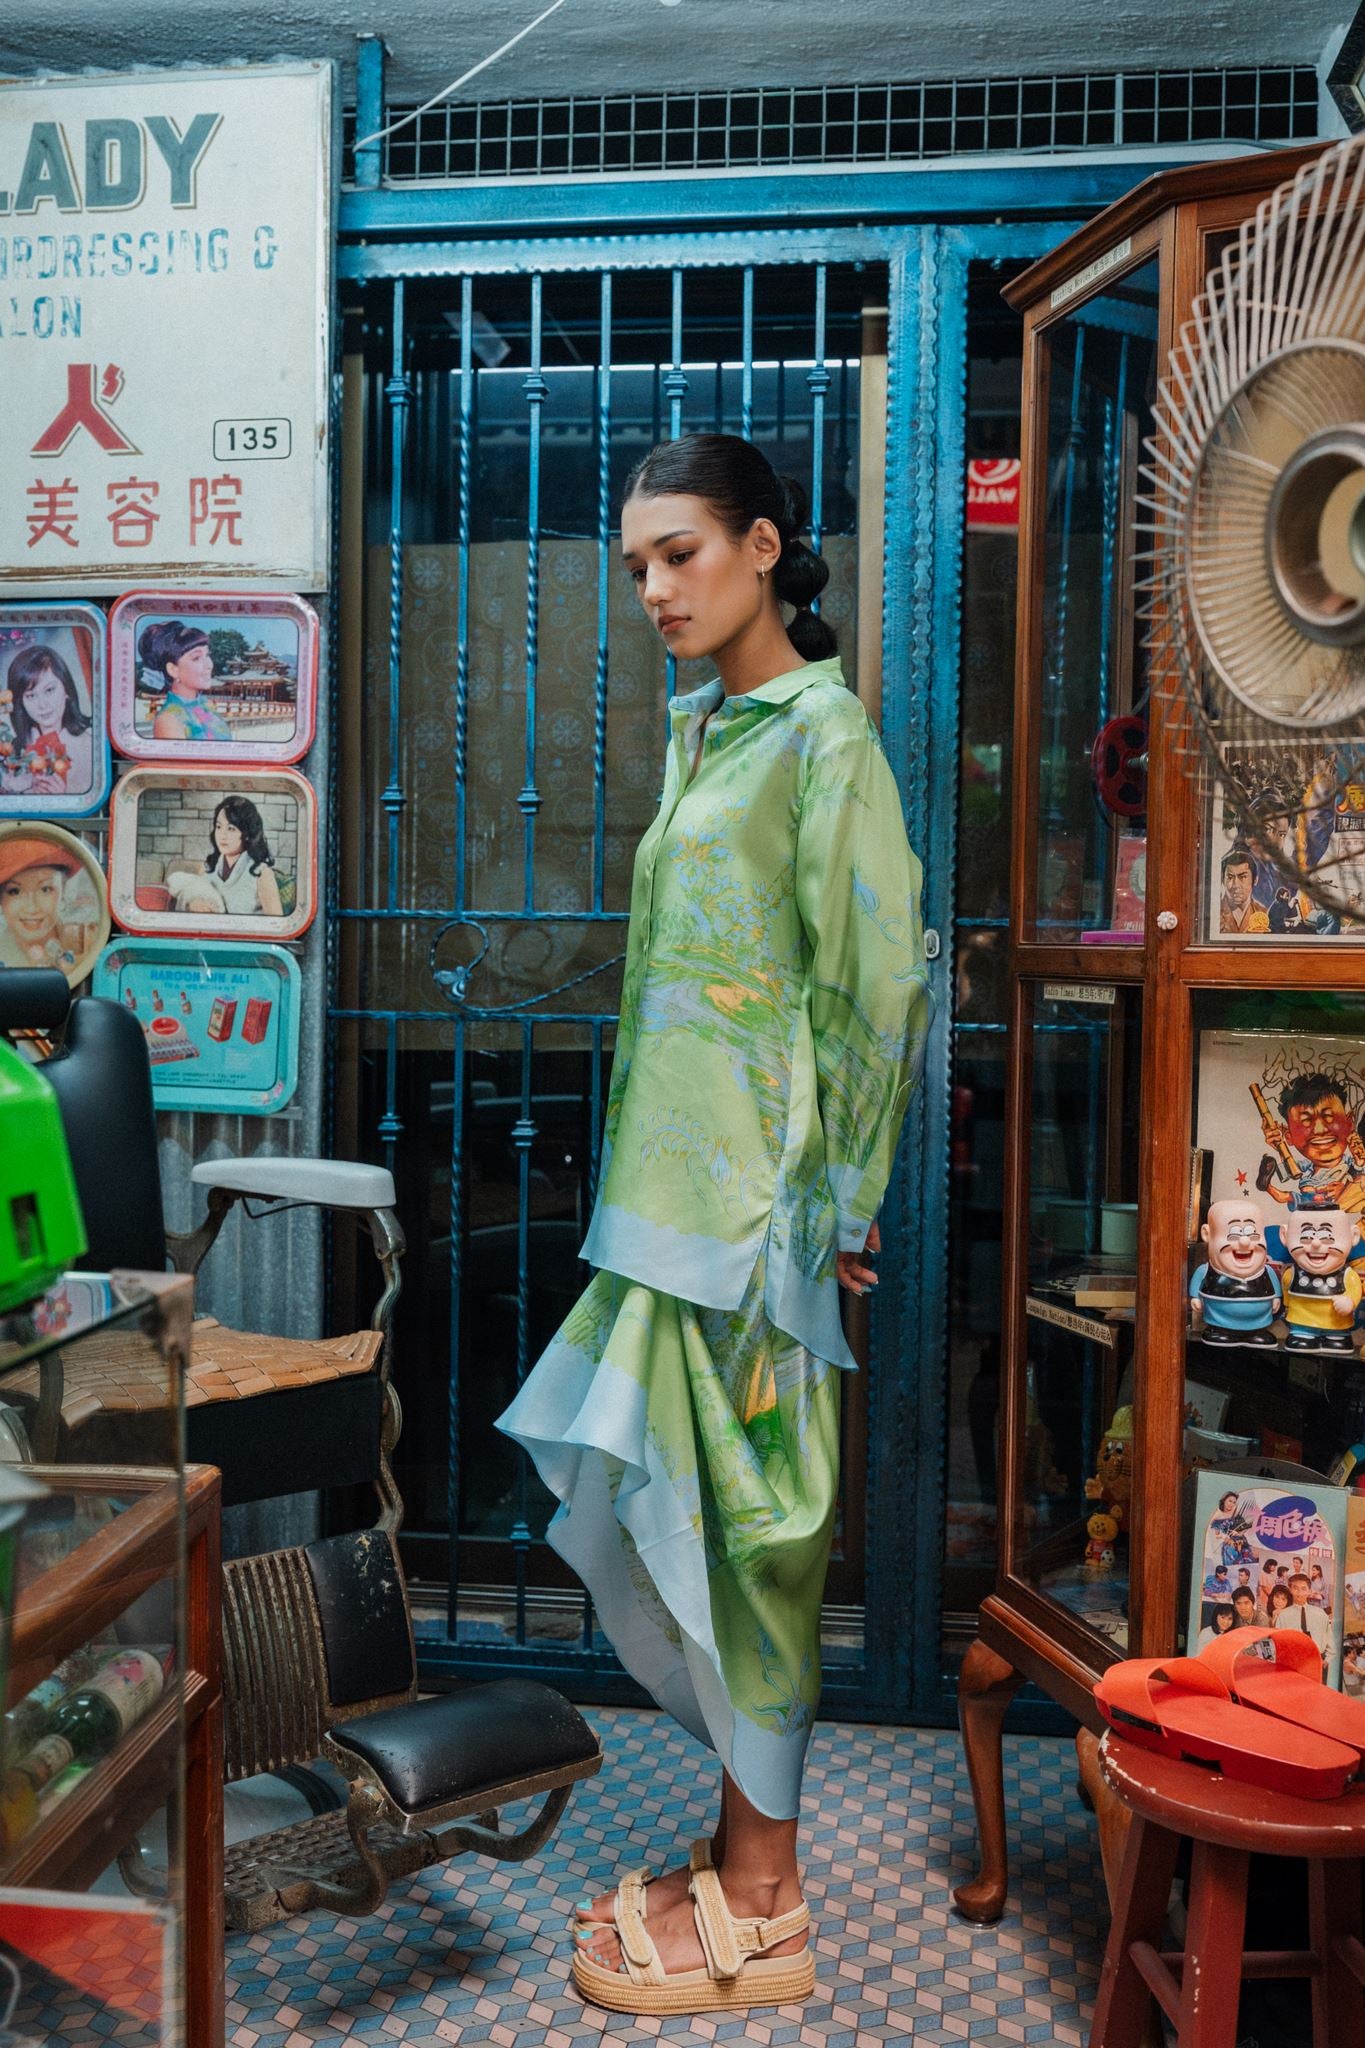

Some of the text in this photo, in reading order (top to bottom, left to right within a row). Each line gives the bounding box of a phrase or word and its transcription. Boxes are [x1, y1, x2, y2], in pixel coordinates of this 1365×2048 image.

[0, 113, 222, 214] ADY
[253, 225, 278, 270] &
[227, 427, 279, 451] 135
[26, 473, 244, 548] 美容院
